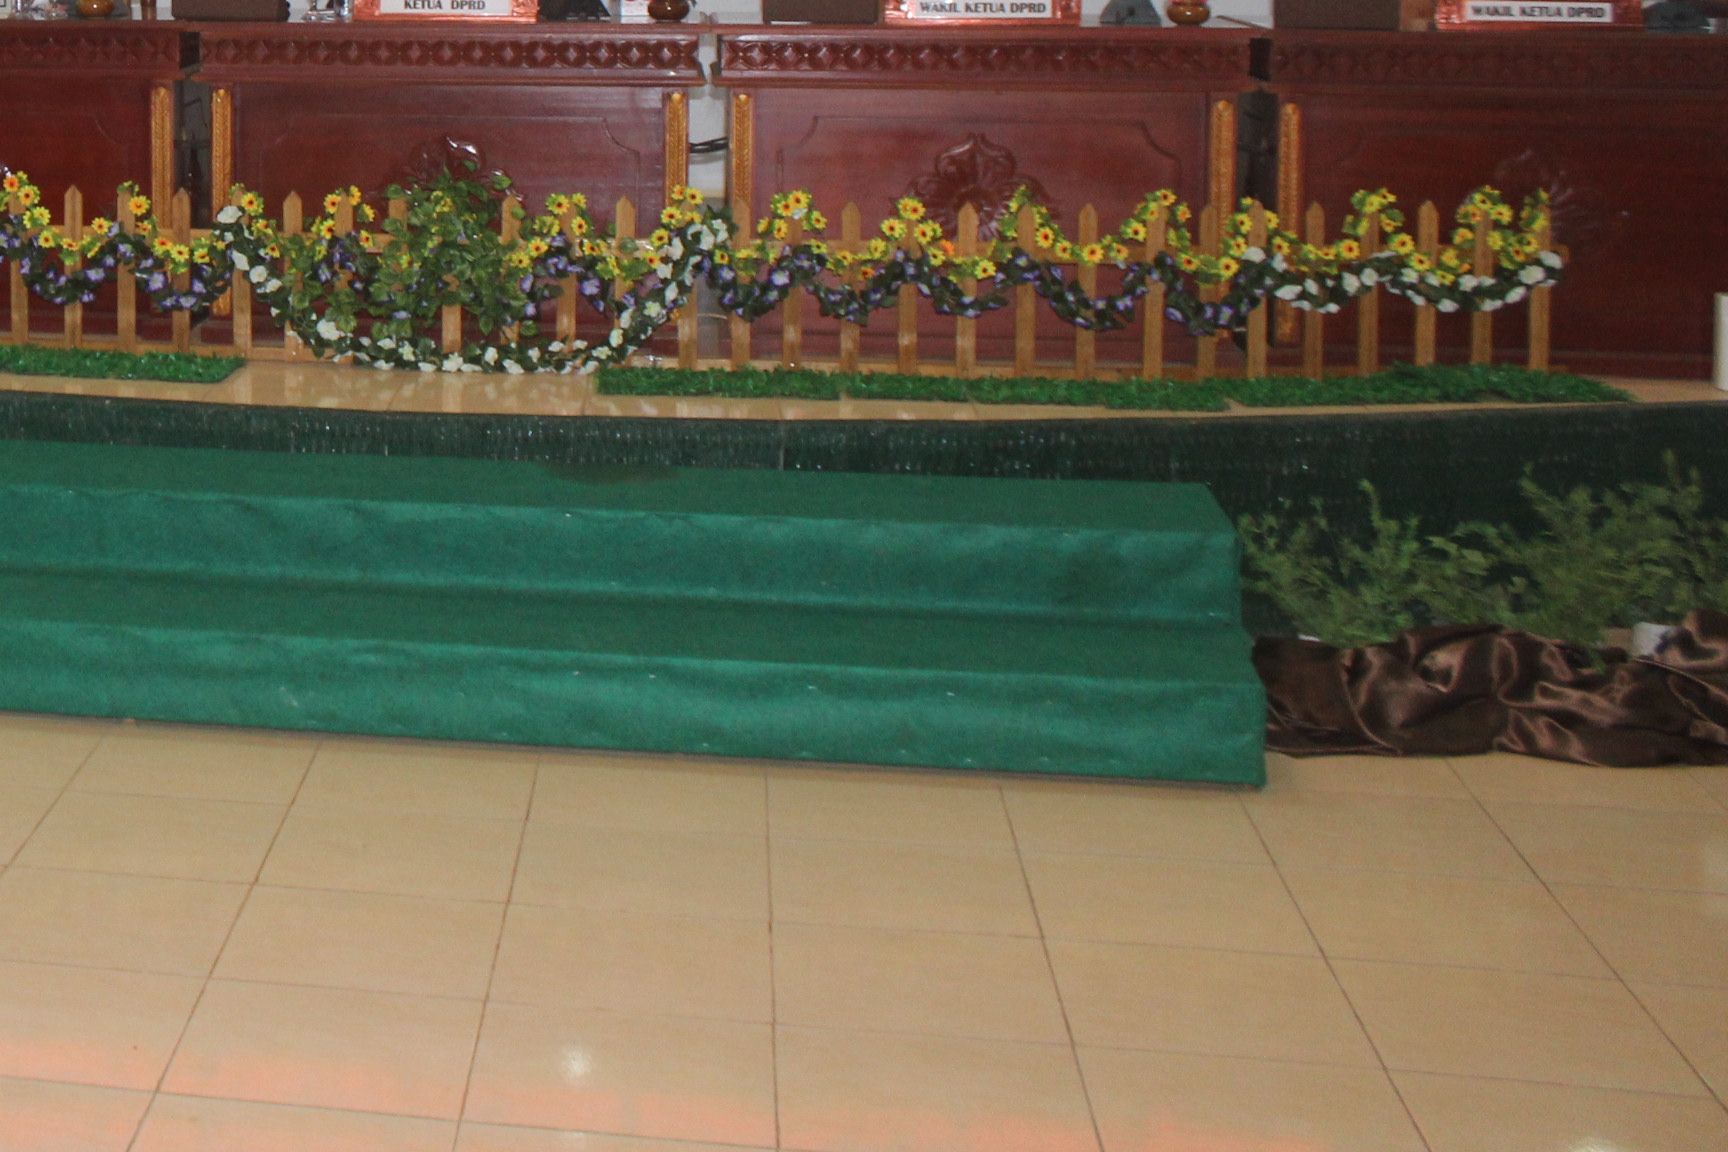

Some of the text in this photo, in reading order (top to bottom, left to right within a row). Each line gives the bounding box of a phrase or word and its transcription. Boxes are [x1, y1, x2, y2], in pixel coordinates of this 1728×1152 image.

[404, 0, 486, 10] KETUA DPRD
[920, 2, 1046, 13] WAKIL KETUA DPRD
